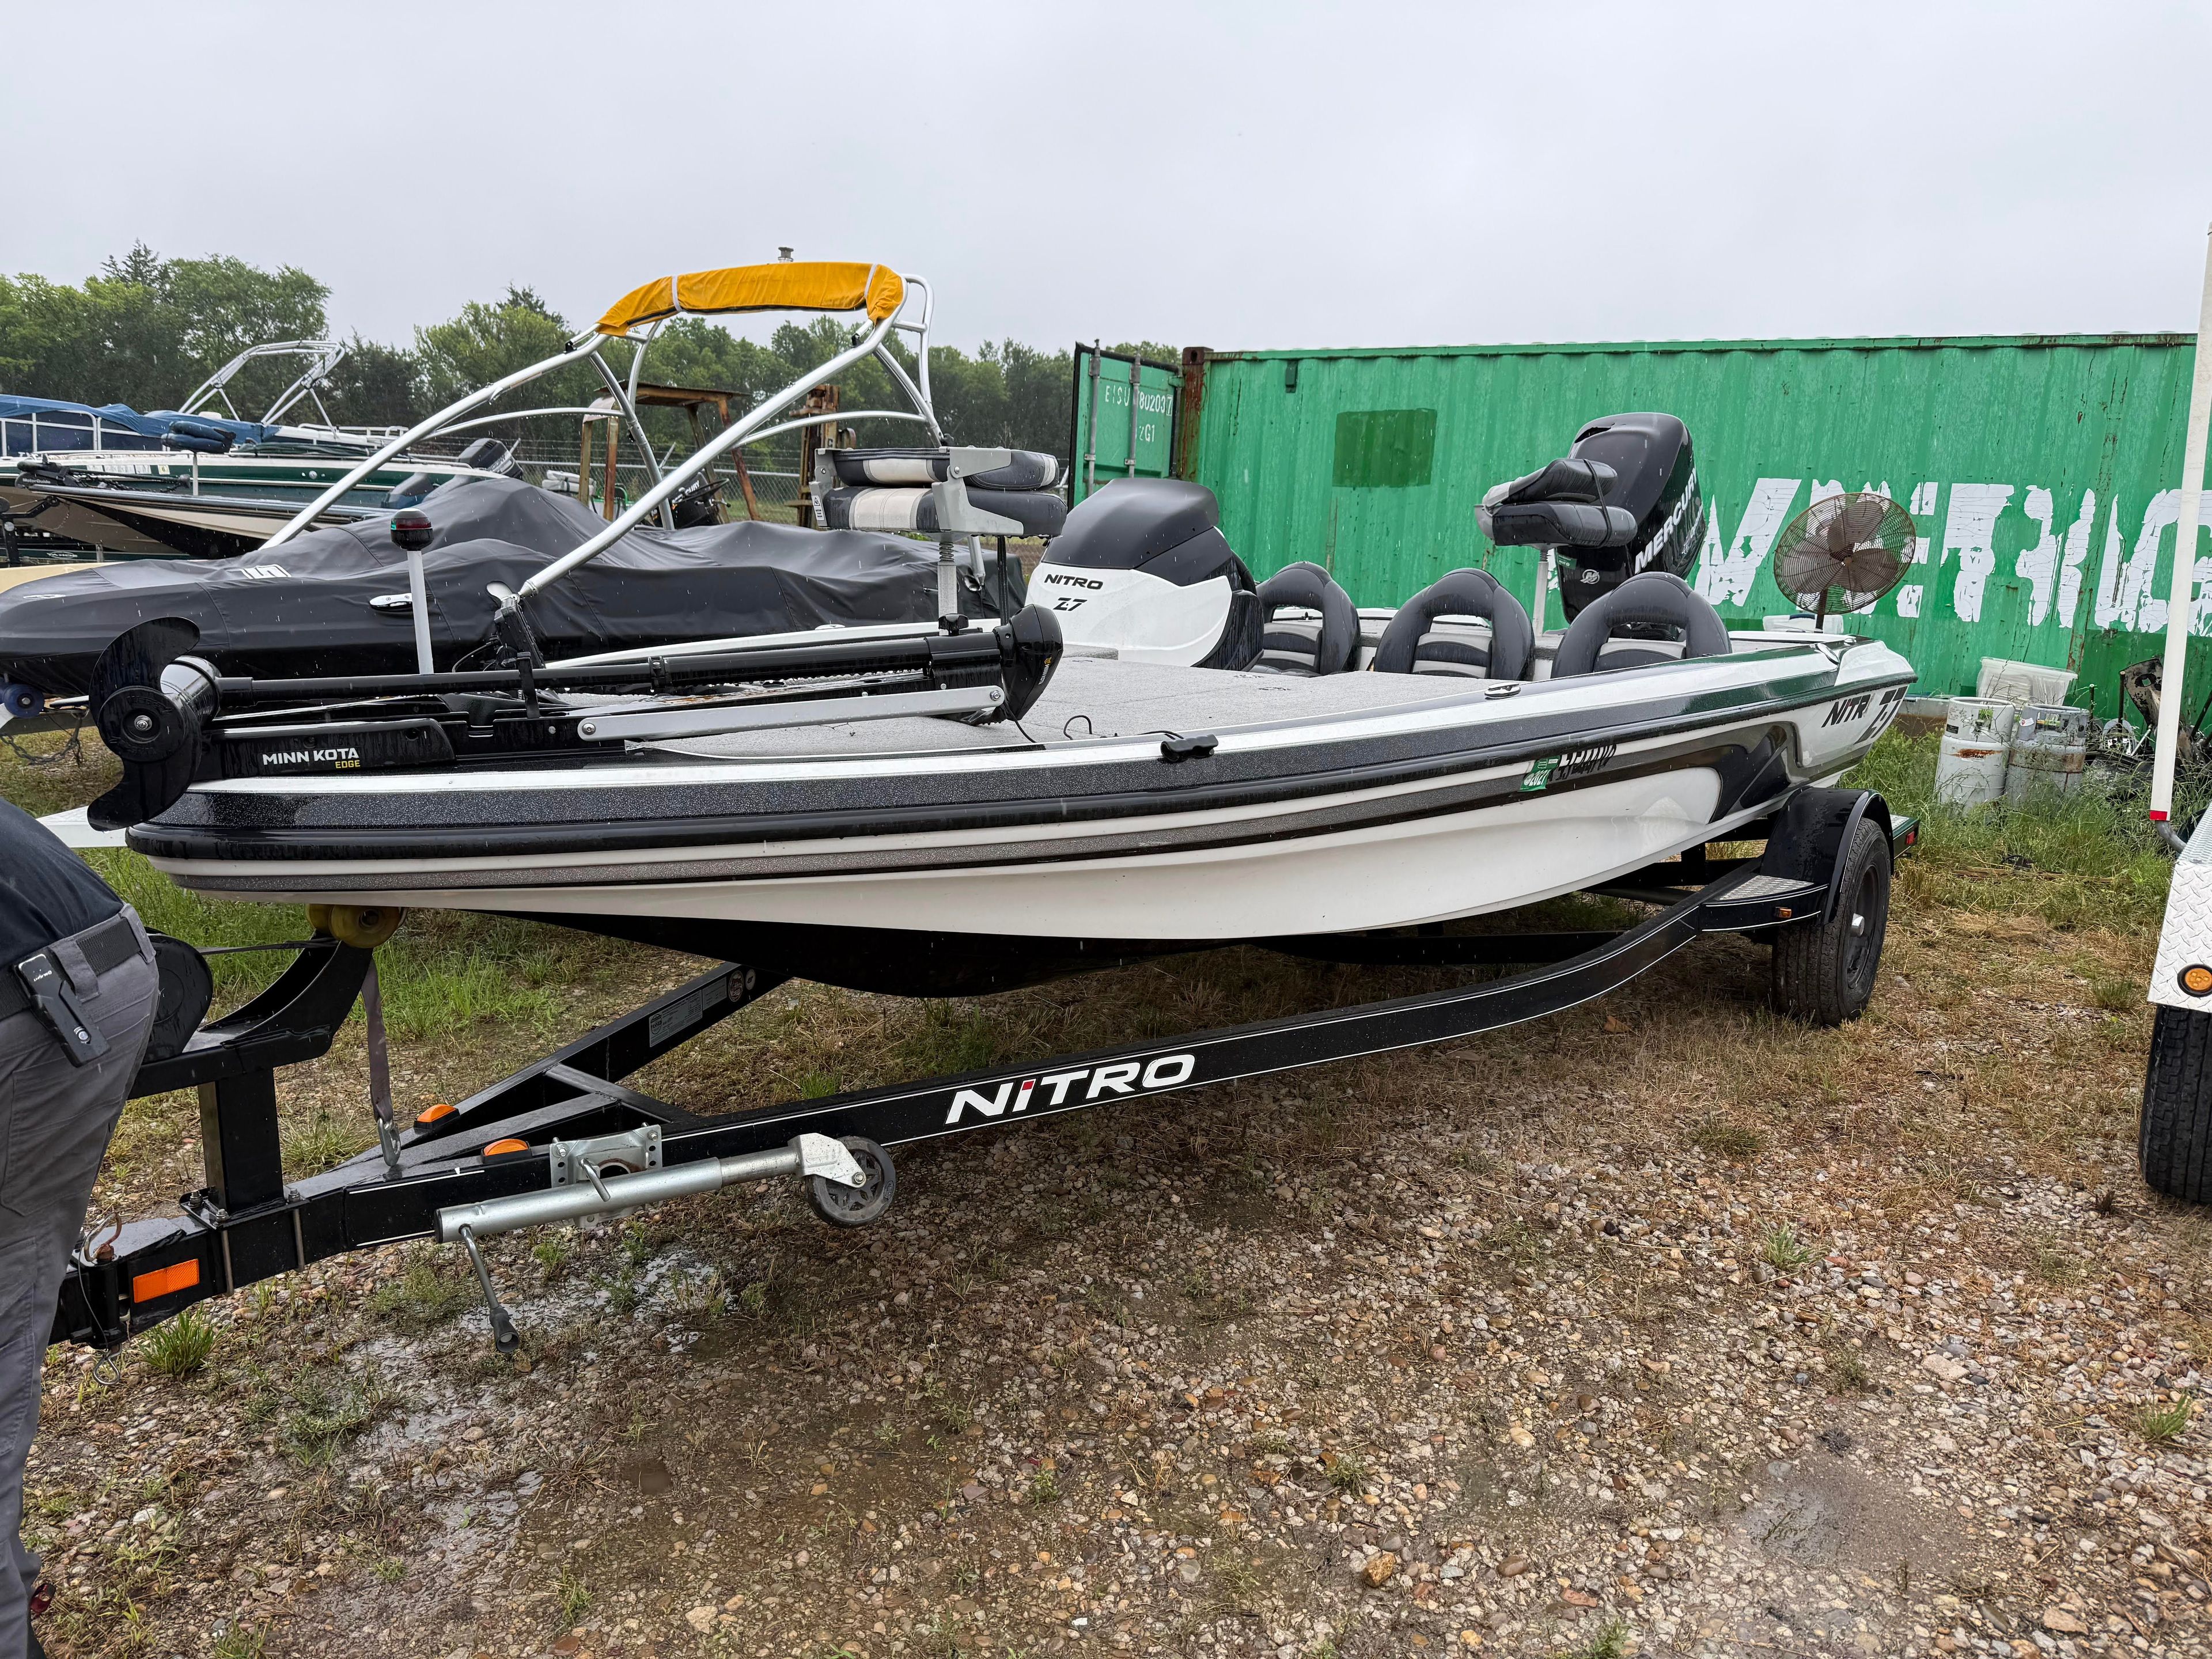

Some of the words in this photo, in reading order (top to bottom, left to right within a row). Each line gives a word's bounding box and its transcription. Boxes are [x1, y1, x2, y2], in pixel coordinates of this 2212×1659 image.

[1137, 389, 1173, 416] 802037
[1044, 574, 1104, 590] NITRO
[262, 751, 310, 766] MINN
[313, 748, 359, 762] KOTA
[335, 760, 361, 769] EDGE
